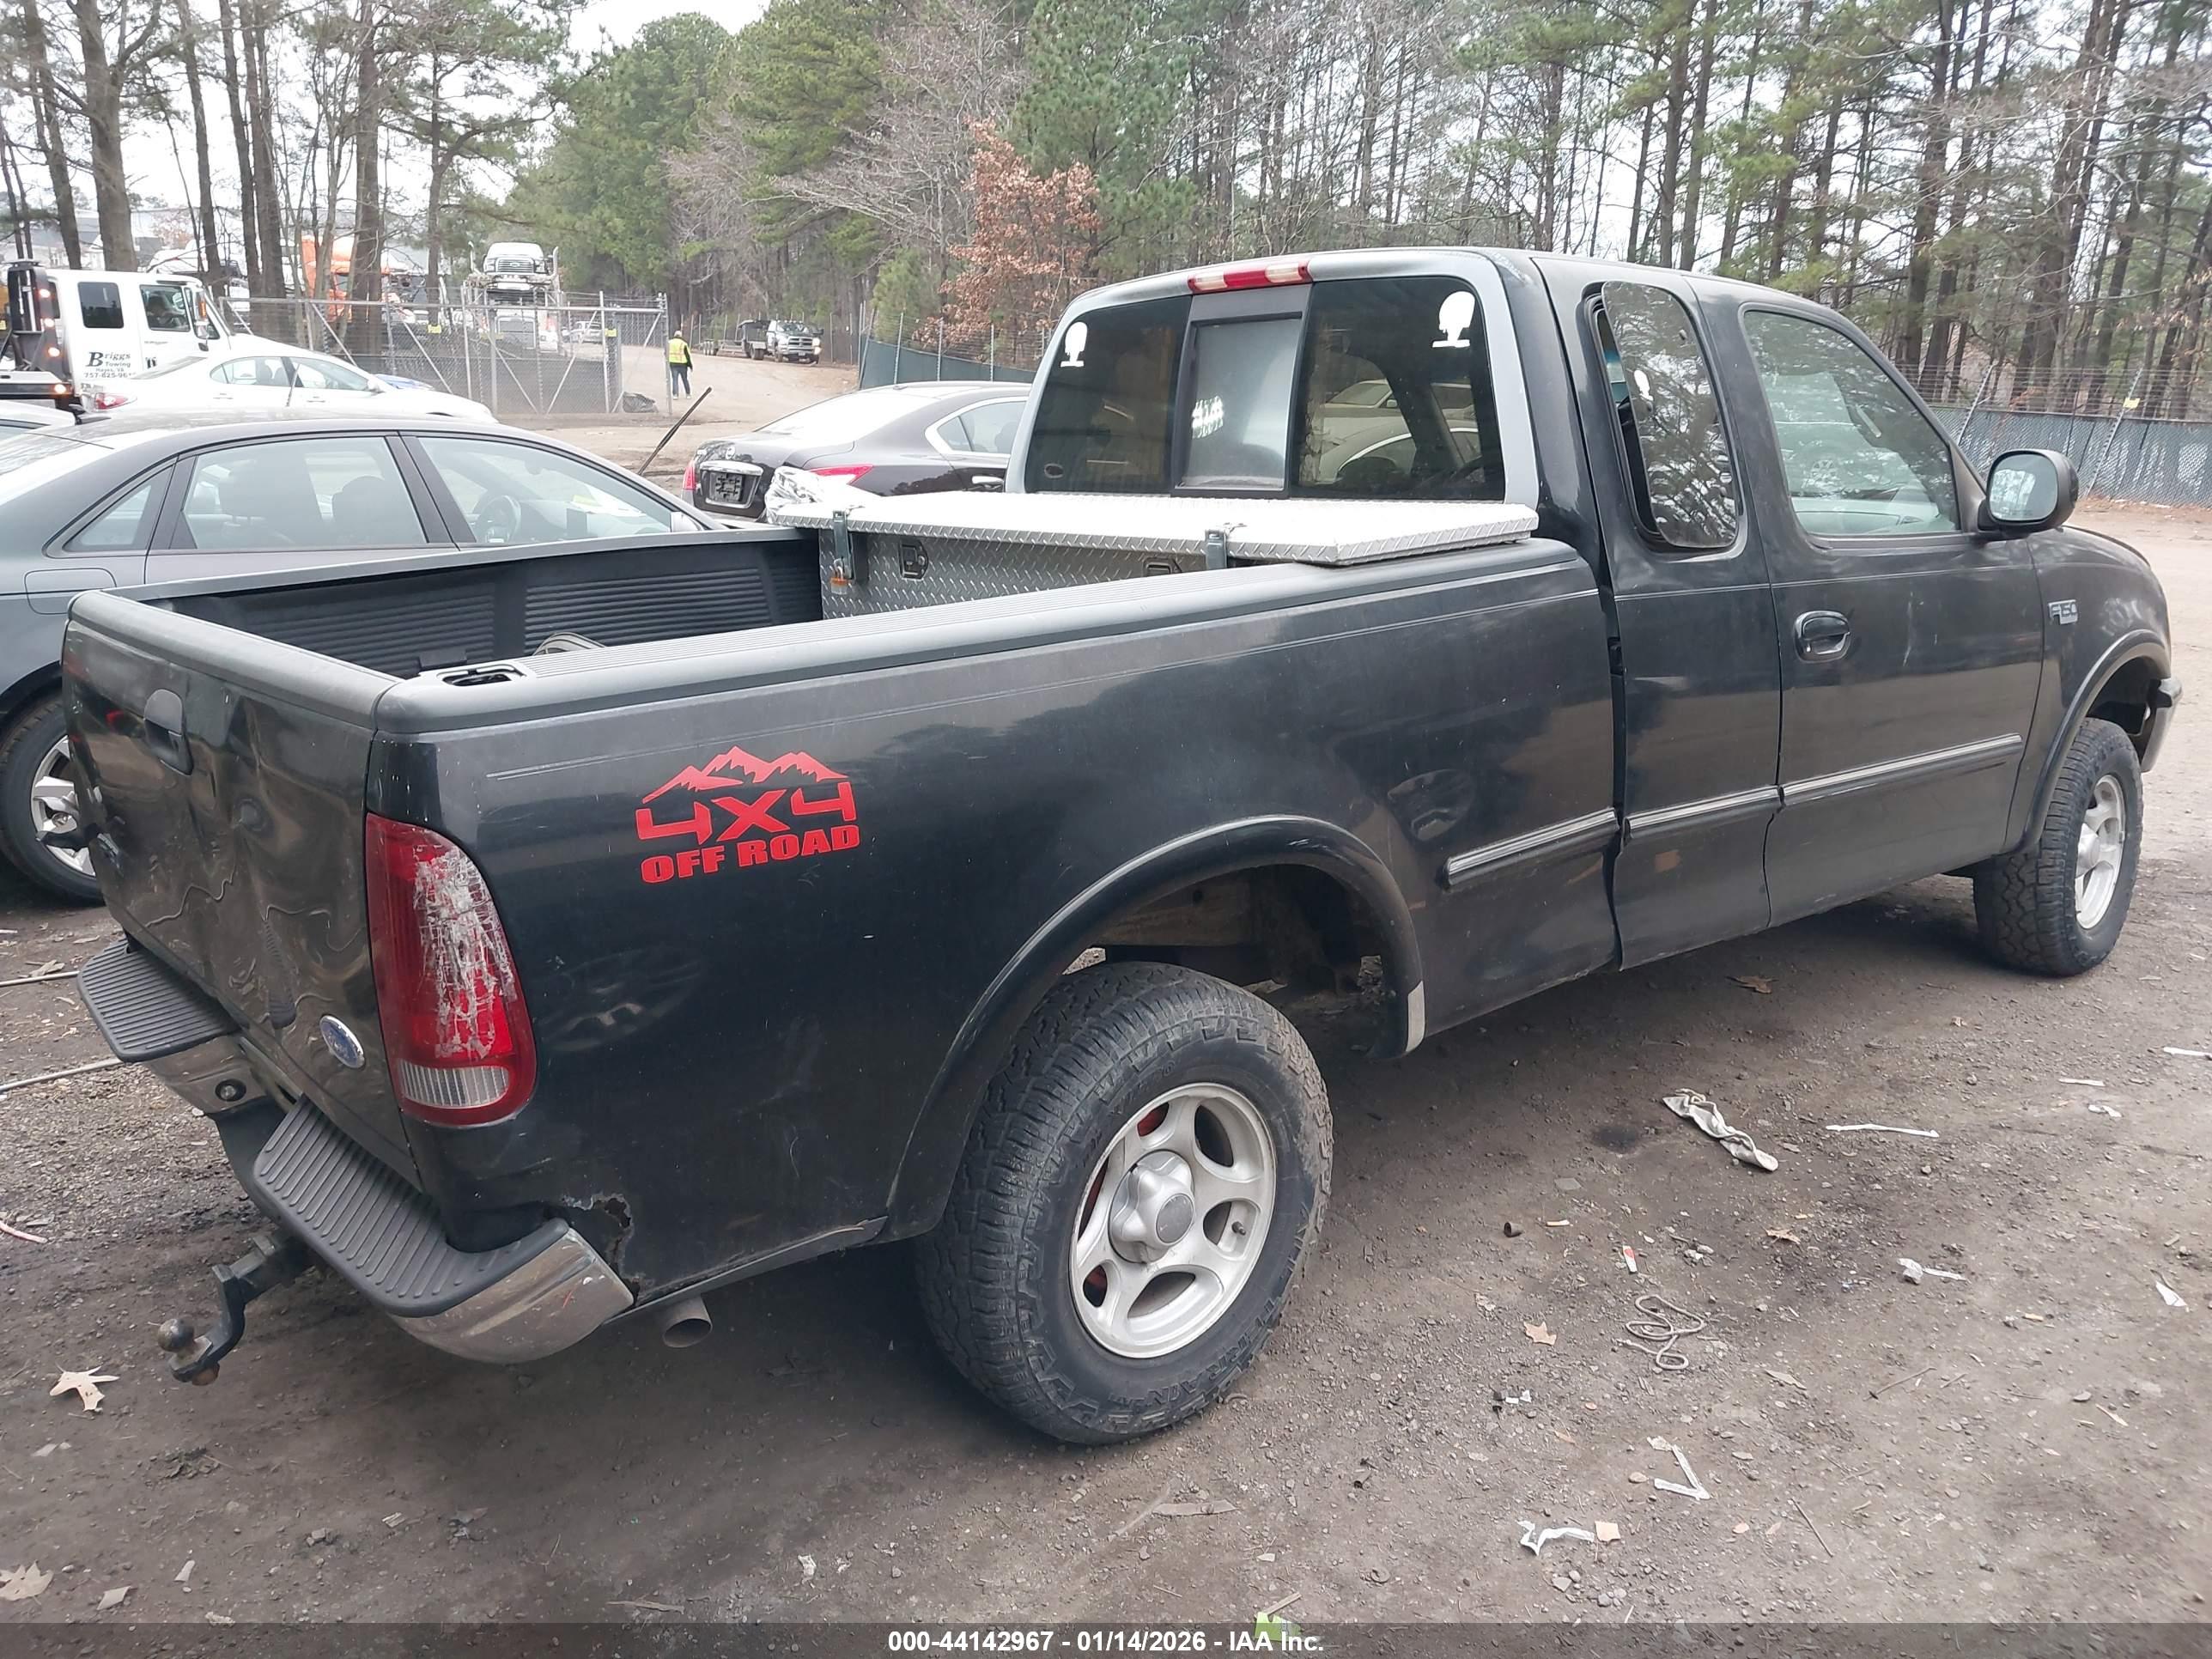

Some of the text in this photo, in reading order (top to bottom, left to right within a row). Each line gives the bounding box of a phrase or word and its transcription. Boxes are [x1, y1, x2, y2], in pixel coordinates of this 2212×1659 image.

[85, 351, 131, 367] Briggs
[641, 824, 860, 884] OFF ROAD
[1148, 1298, 1276, 1403] TERRAIN
